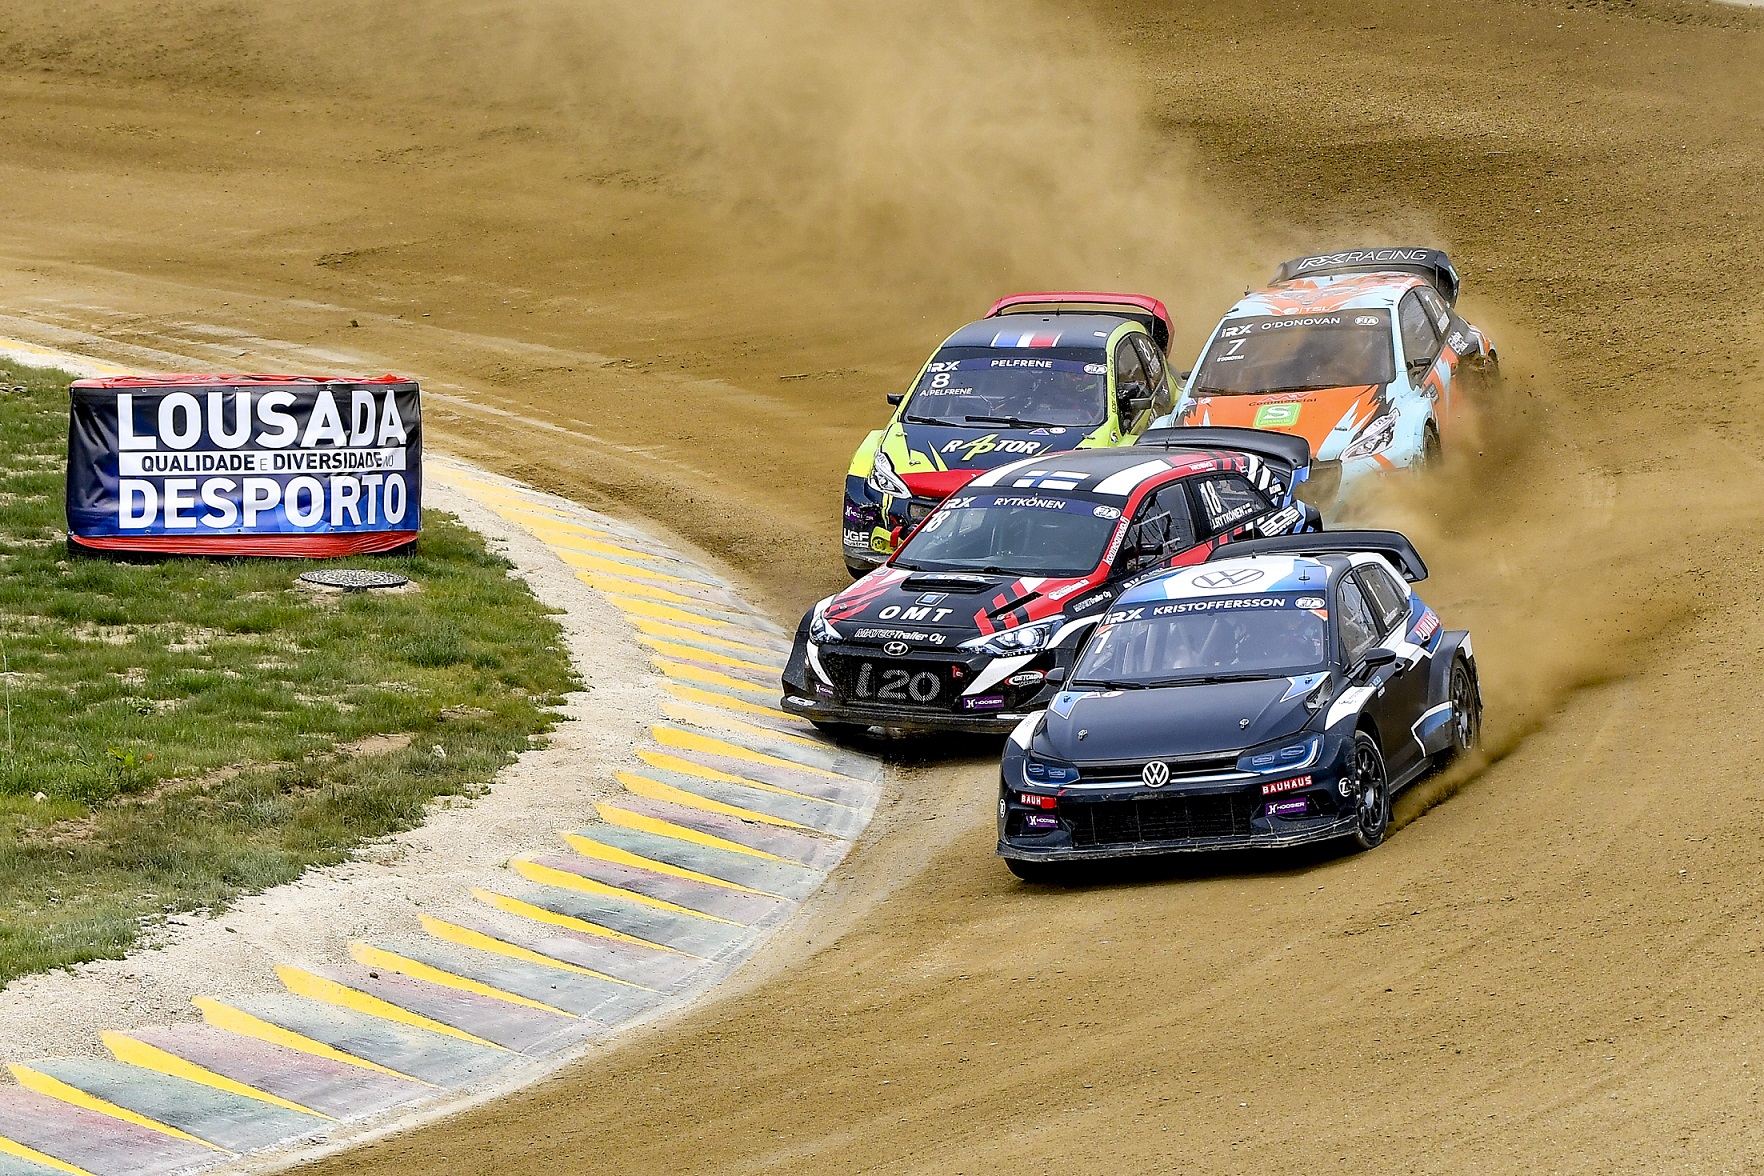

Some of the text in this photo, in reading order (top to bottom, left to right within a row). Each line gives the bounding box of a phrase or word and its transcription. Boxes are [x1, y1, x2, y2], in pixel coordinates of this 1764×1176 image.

[1261, 318, 1340, 330] O'DONOVAN
[1228, 338, 1247, 356] 7
[991, 359, 1053, 369] PELFRENE
[931, 372, 951, 388] 8
[1248, 398, 1317, 407] Commercial
[117, 390, 407, 450] LOUSADA
[940, 433, 1041, 461] RAPTOR
[141, 453, 255, 472] QUALIDADE
[259, 457, 268, 471] E
[273, 451, 383, 471] DIVERSIDADE
[118, 473, 407, 529] DESPORTO
[994, 496, 1066, 511] RYTKÖNEN
[1199, 480, 1222, 516] 18
[921, 509, 951, 533] 18
[843, 527, 870, 541] UGF
[878, 605, 954, 623] OMT
[1153, 598, 1286, 616] KRISTOFFERSSON
[1297, 597, 1324, 609] FIA
[928, 632, 947, 645] Oy
[1094, 630, 1113, 654] 1
[855, 662, 941, 702] i20
[1262, 775, 1312, 794] BAUHAUS
[1277, 801, 1305, 811] HOOSIER
